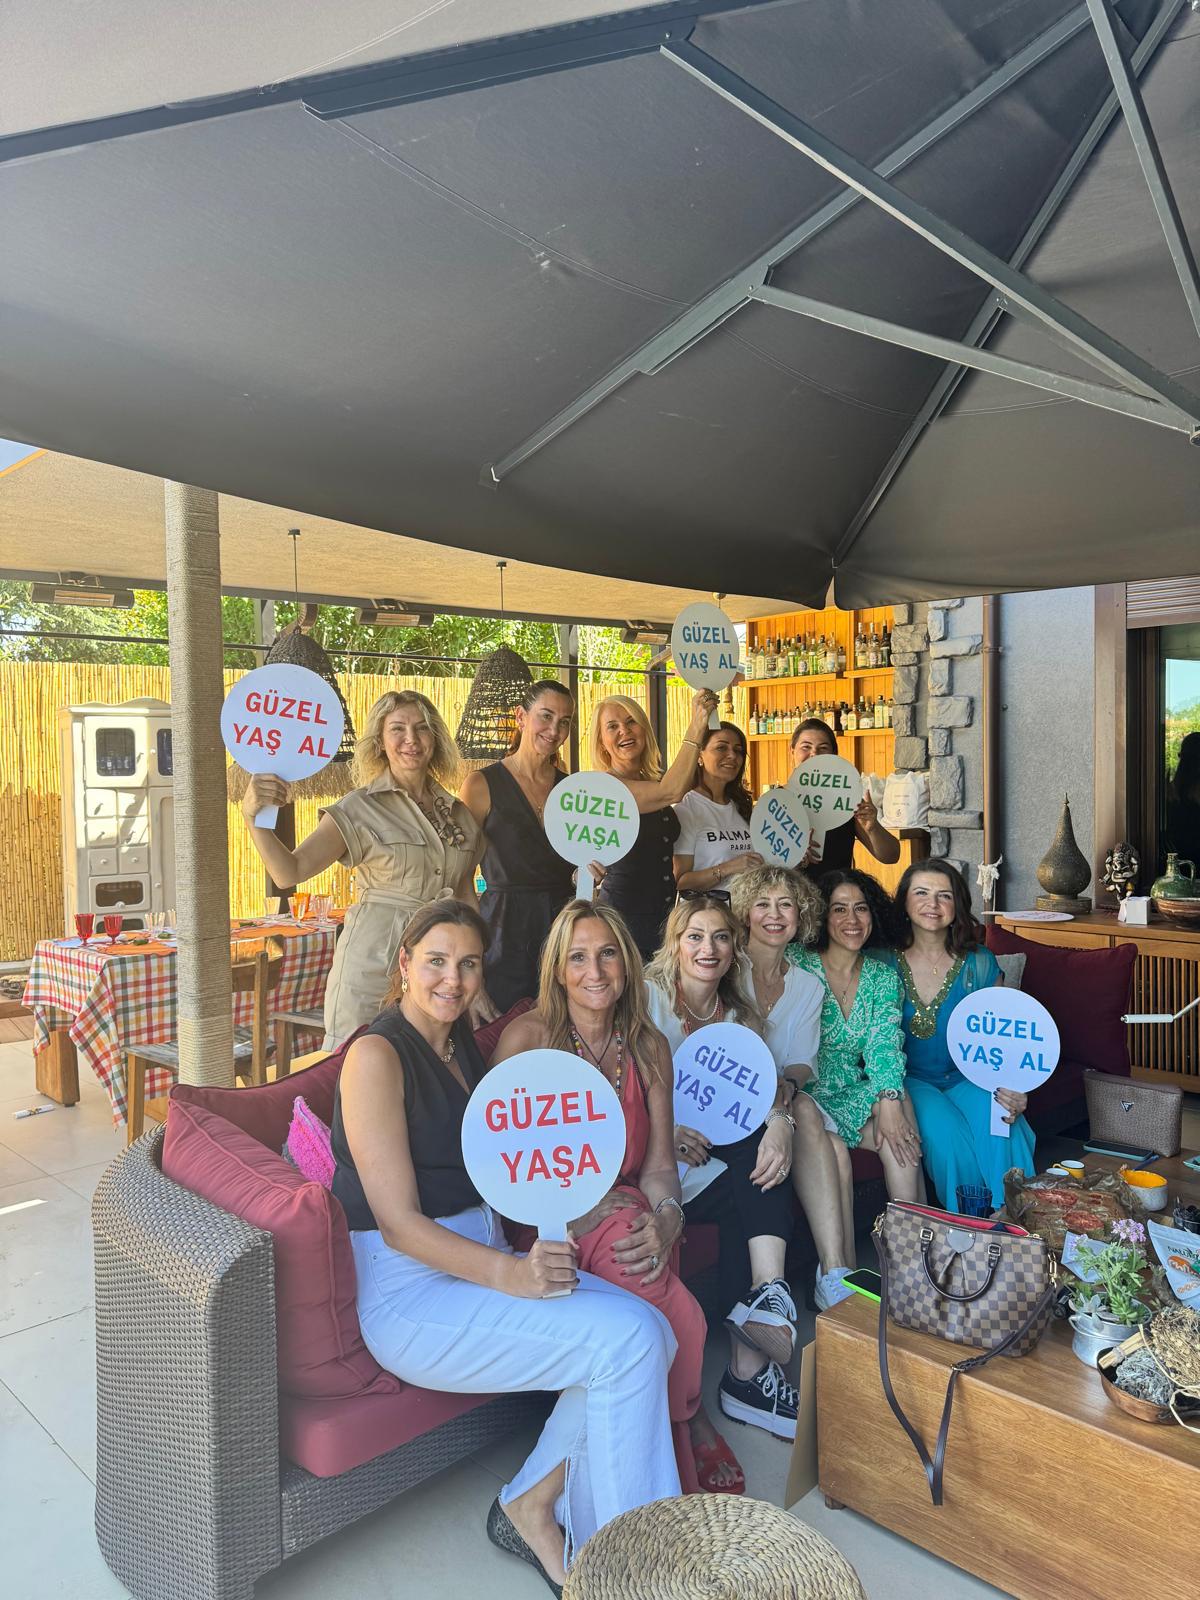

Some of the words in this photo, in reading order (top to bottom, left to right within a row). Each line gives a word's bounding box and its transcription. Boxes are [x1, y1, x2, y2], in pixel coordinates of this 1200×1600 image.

[682, 621, 730, 644] GÜZEL
[679, 652, 709, 674] YAŞ
[718, 653, 737, 669] AL
[245, 689, 328, 725] GÜZEL
[233, 723, 282, 756] YAŞ
[297, 735, 331, 758] AL
[798, 769, 852, 789] GÜZEL
[560, 789, 630, 820] GÜZEL
[797, 793, 823, 813] AŞ
[833, 796, 854, 811] AL
[565, 822, 621, 851] YAŞA
[768, 798, 804, 848] GÜZEL
[730, 843, 751, 851] PARIS
[760, 820, 791, 864] YAŞA
[966, 1011, 1044, 1042] GÜZEL
[694, 1045, 760, 1097] GÜZEL
[958, 1043, 1004, 1072] YAŞ
[1020, 1051, 1051, 1073] AL
[485, 1087, 607, 1133] GÜZEL
[675, 1069, 716, 1112] YAŞ
[723, 1100, 752, 1132] AL
[500, 1143, 601, 1188] YAŞA
